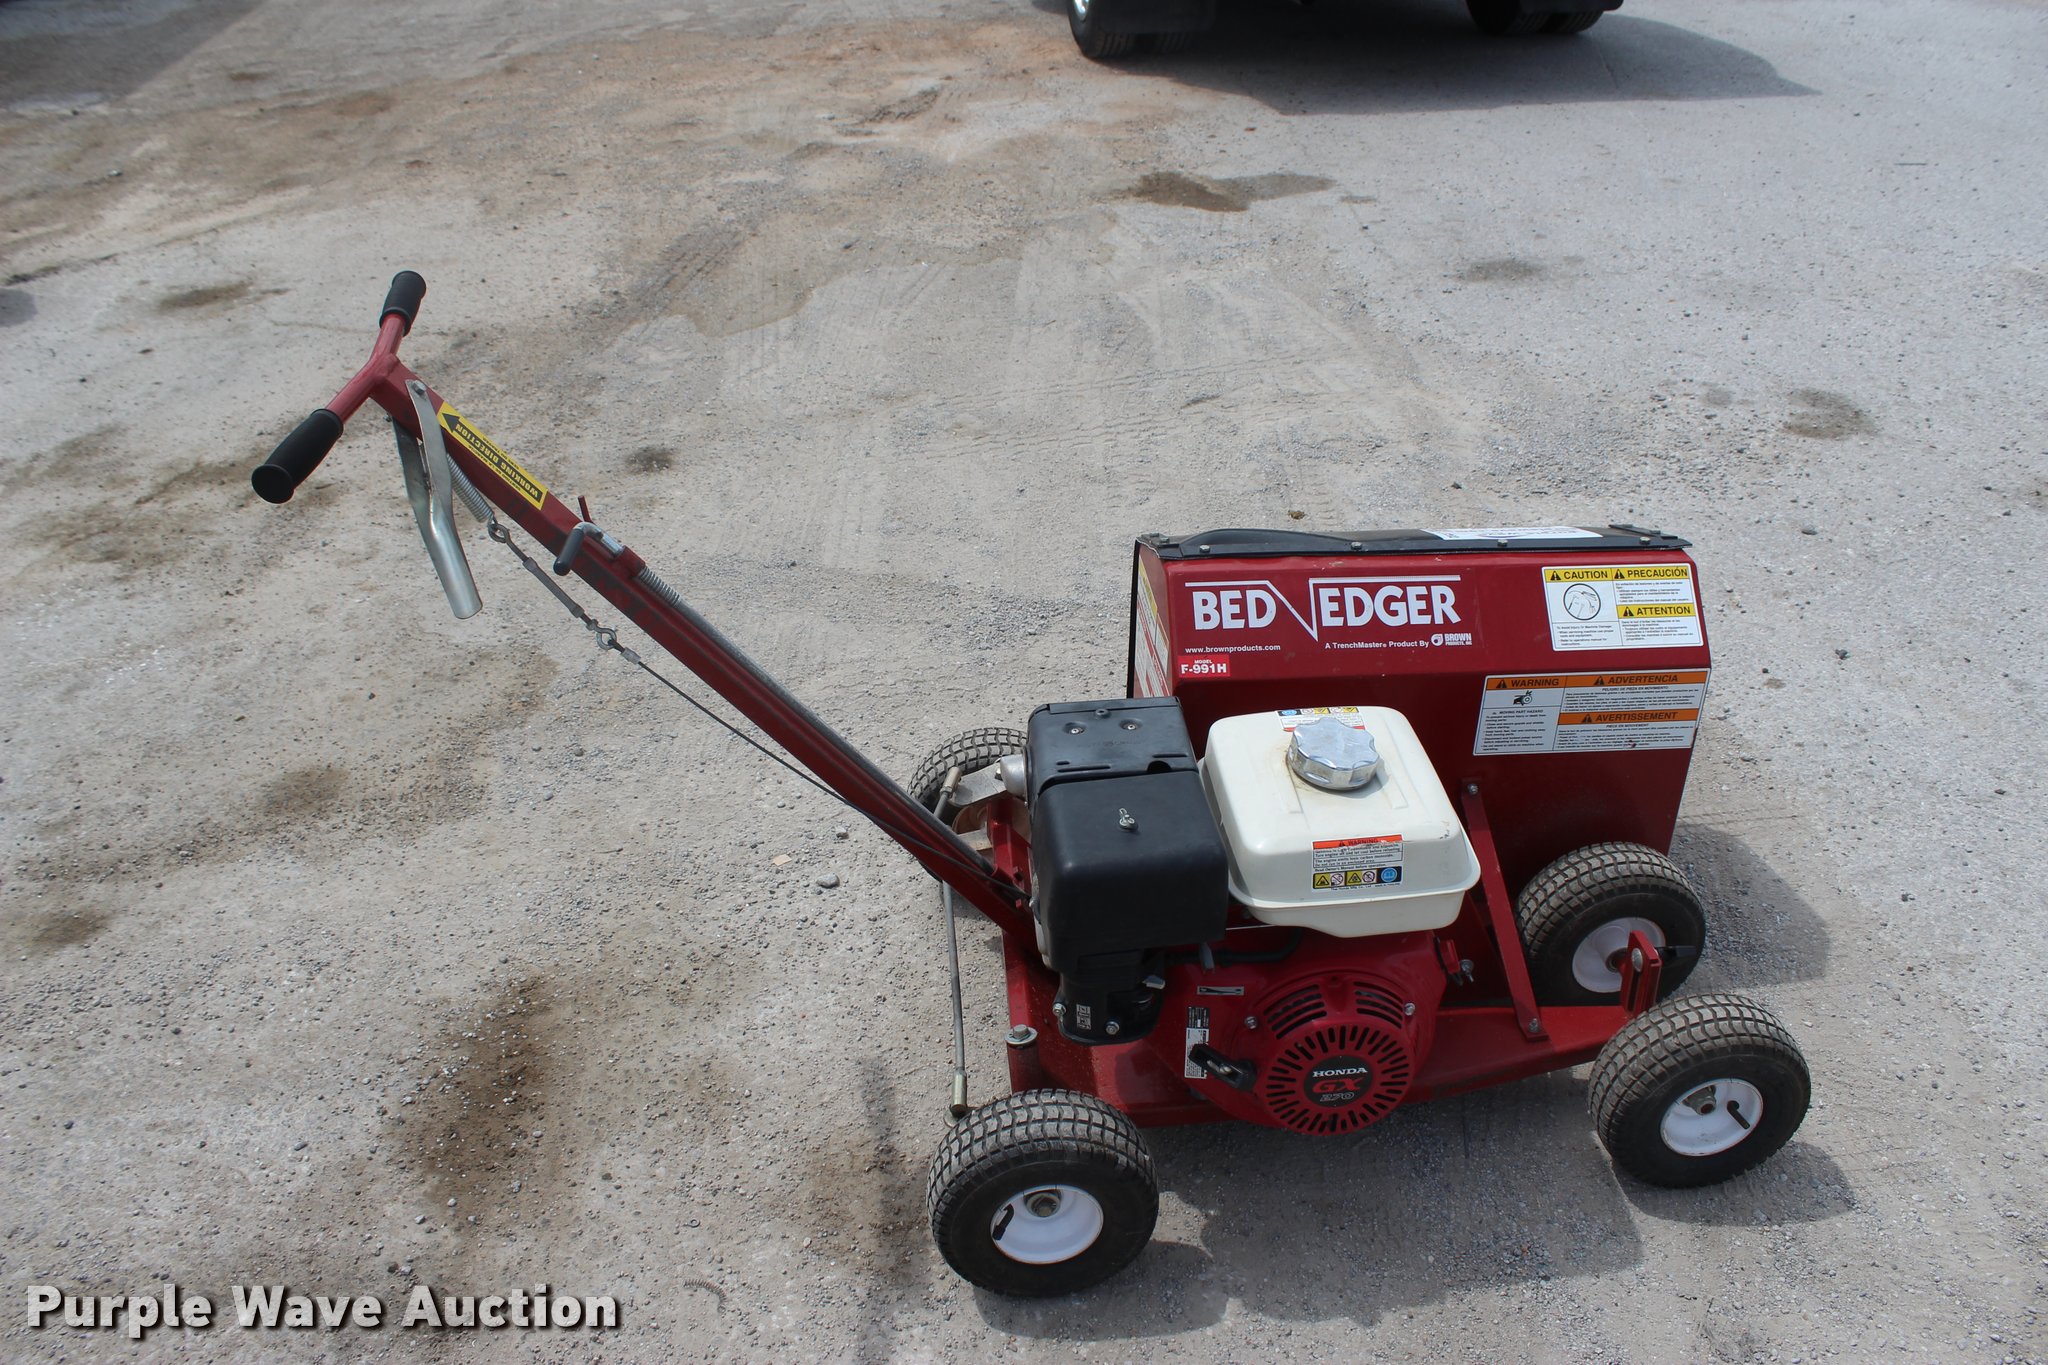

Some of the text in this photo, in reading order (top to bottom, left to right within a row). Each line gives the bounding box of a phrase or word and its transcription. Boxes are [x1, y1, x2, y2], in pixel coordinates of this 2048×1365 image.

[455, 424, 538, 497] WORKING DIRECTION
[1564, 571, 1608, 580] CAUTION
[1627, 567, 1688, 578] PRECAUCIÓN
[1192, 589, 1277, 630] BED
[1318, 585, 1462, 627] EDGER
[1636, 606, 1691, 616] ATTENTION
[1444, 633, 1472, 641] BROWN
[1184, 645, 1281, 653] www.brownproducts.com
[1419, 640, 1429, 649] By
[1180, 663, 1227, 674] F-991H
[1511, 678, 1560, 688] WARNING
[1608, 674, 1678, 685] ADVERTENCIA
[1595, 711, 1678, 722] AVERTISSEMENT
[1312, 1067, 1368, 1077] HONDA
[1312, 1077, 1363, 1093] GX
